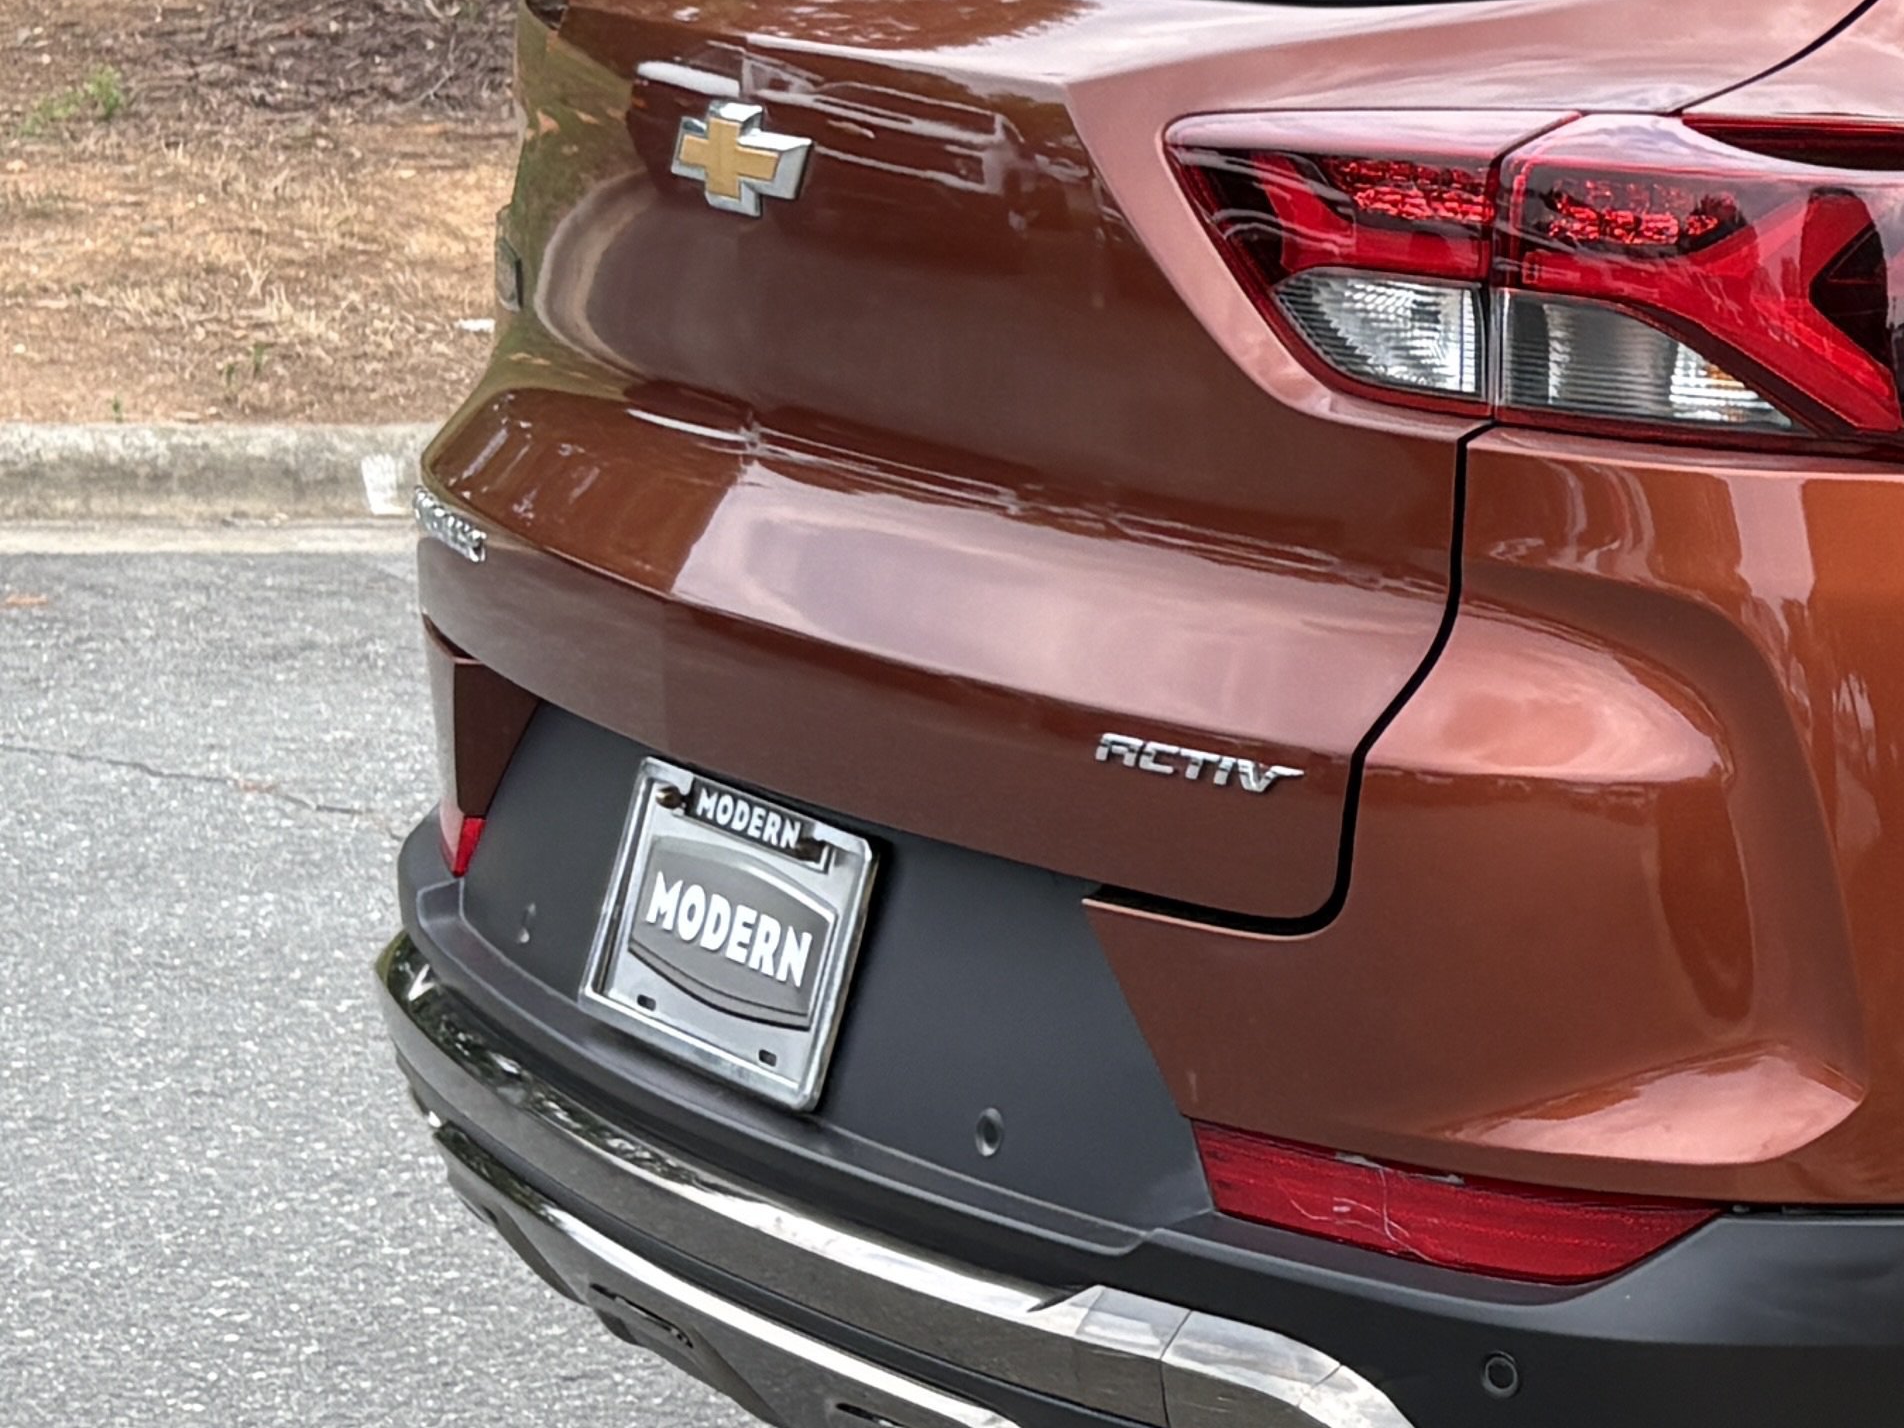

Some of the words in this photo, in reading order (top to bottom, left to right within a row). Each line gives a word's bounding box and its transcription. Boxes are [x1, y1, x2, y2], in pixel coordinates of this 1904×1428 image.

[1095, 732, 1305, 793] ACTIV
[696, 787, 802, 850] MODERN
[645, 870, 813, 988] MODERN
